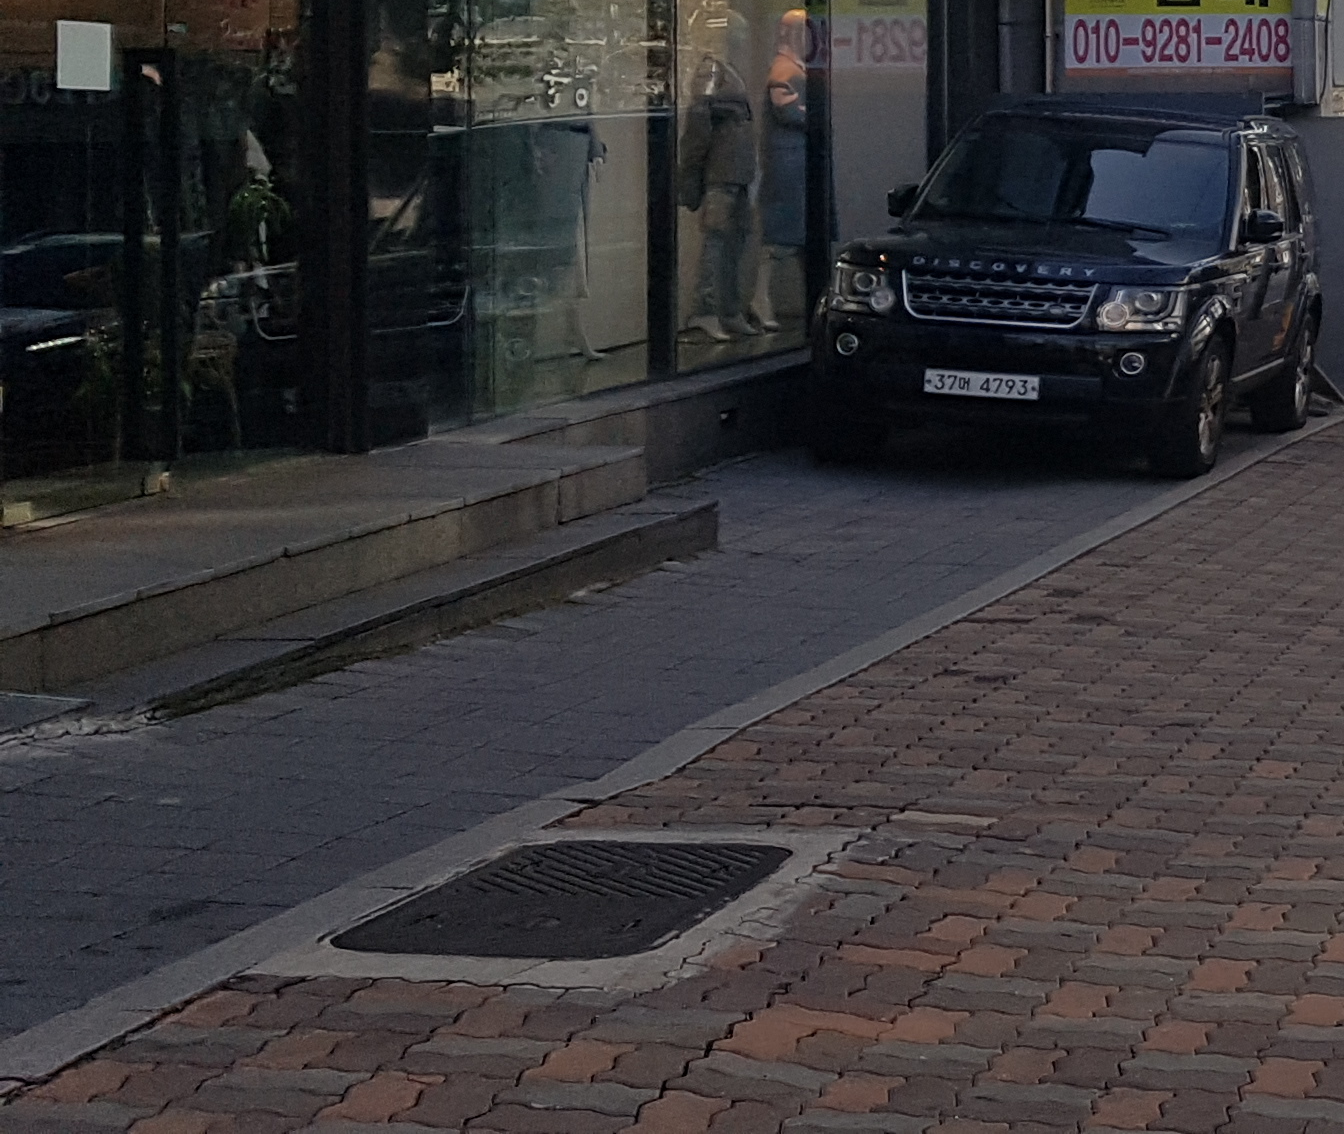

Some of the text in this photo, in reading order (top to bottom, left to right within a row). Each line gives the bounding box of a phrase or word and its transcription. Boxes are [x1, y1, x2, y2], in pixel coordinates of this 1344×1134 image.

[1073, 18, 1290, 63] 010-9281-2408
[913, 256, 1095, 277] DISCOVERY
[980, 377, 1028, 396] 4793
